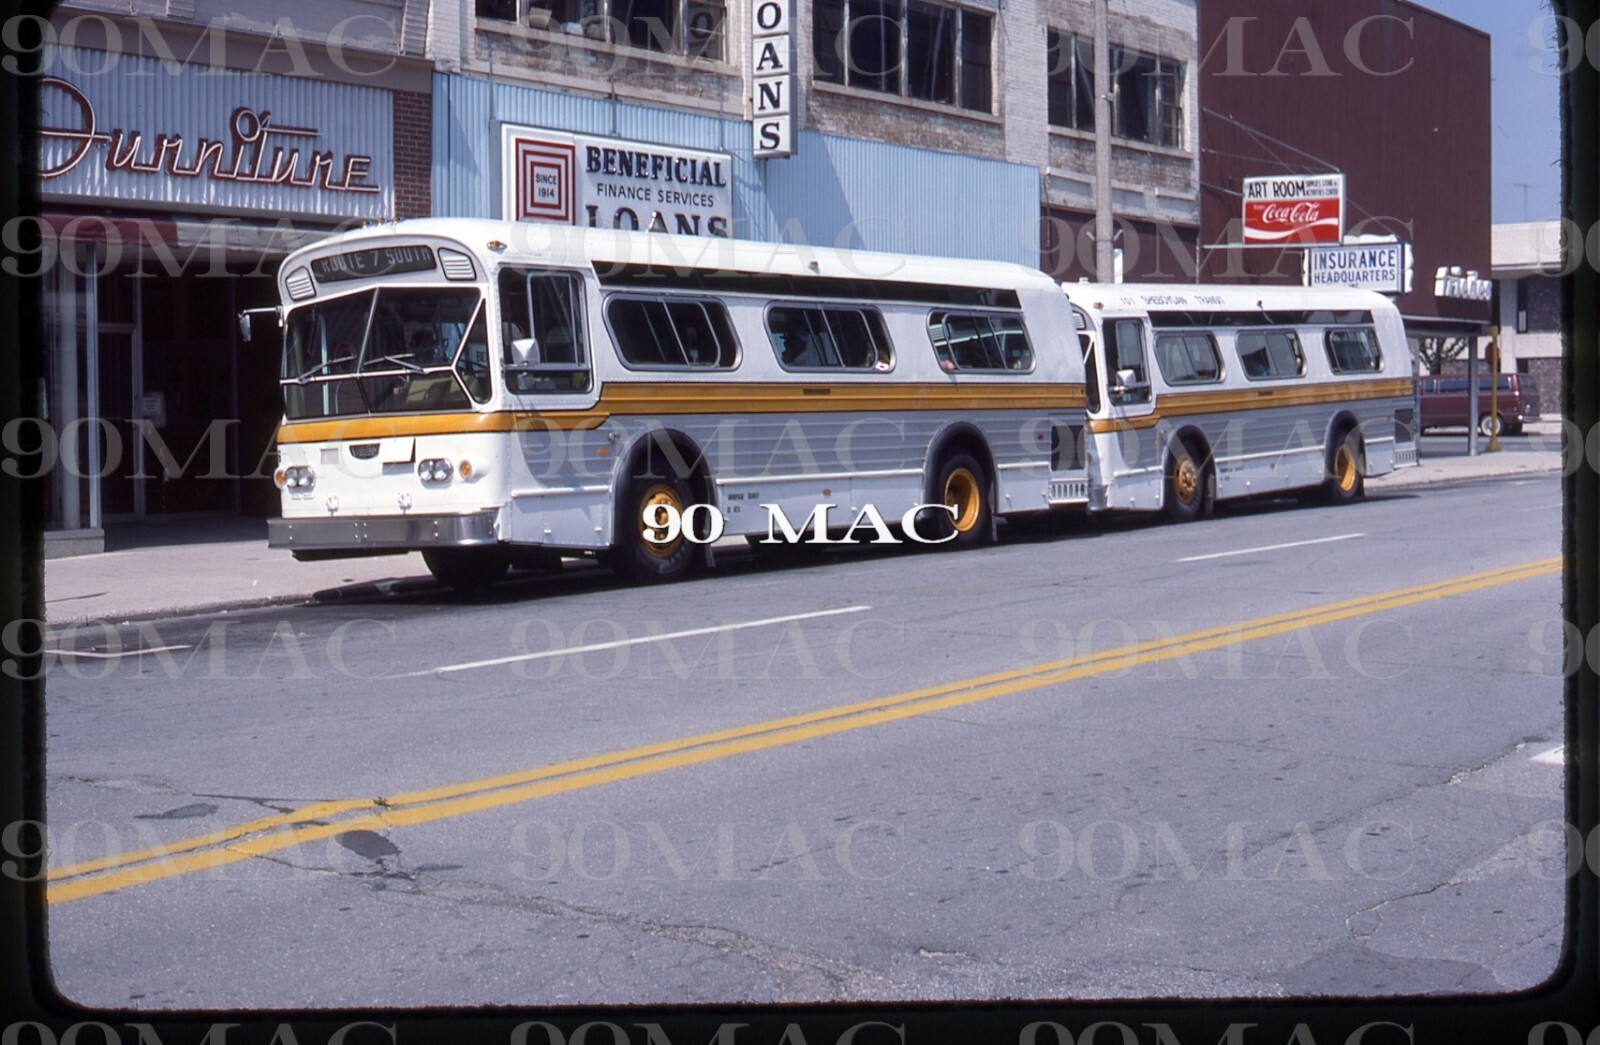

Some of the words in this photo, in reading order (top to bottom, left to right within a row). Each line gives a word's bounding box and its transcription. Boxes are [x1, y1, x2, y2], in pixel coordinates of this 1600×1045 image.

[585, 145, 726, 187] BENEFICIAL
[535, 173, 557, 185] SINCE
[1248, 182, 1268, 198] ART
[1272, 180, 1306, 198] ROOM
[538, 187, 555, 199] 1914
[597, 183, 651, 202] FINANCE
[657, 190, 714, 208] SERVICES
[1262, 202, 1321, 224] Coca-Cola
[321, 252, 365, 273] ROUTE
[369, 250, 378, 267] 7
[385, 246, 431, 265] SOUTH
[1314, 249, 1396, 270] INSURANCE
[1314, 269, 1396, 284] HEADQUARTERS
